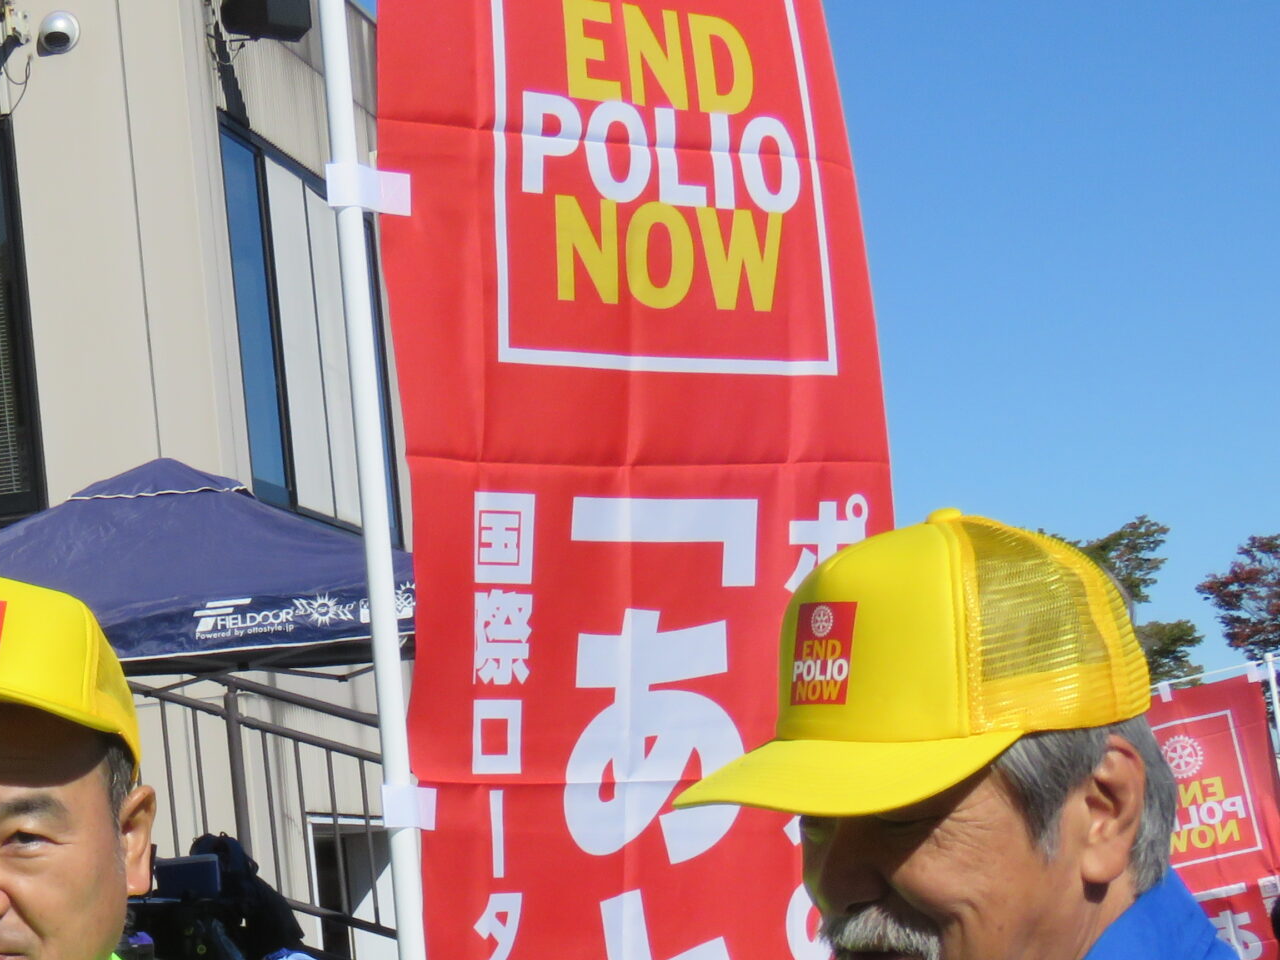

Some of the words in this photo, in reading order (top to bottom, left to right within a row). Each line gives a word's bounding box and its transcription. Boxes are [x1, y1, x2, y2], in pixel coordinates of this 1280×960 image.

[561, 0, 753, 115] END
[521, 90, 801, 214] POLIO
[554, 194, 783, 312] NOW
[217, 609, 294, 630] FIELDOOR
[195, 630, 231, 640] Powered
[234, 628, 245, 637] by
[802, 639, 842, 660] END
[793, 658, 849, 682] POLIO
[796, 680, 842, 701] NOW
